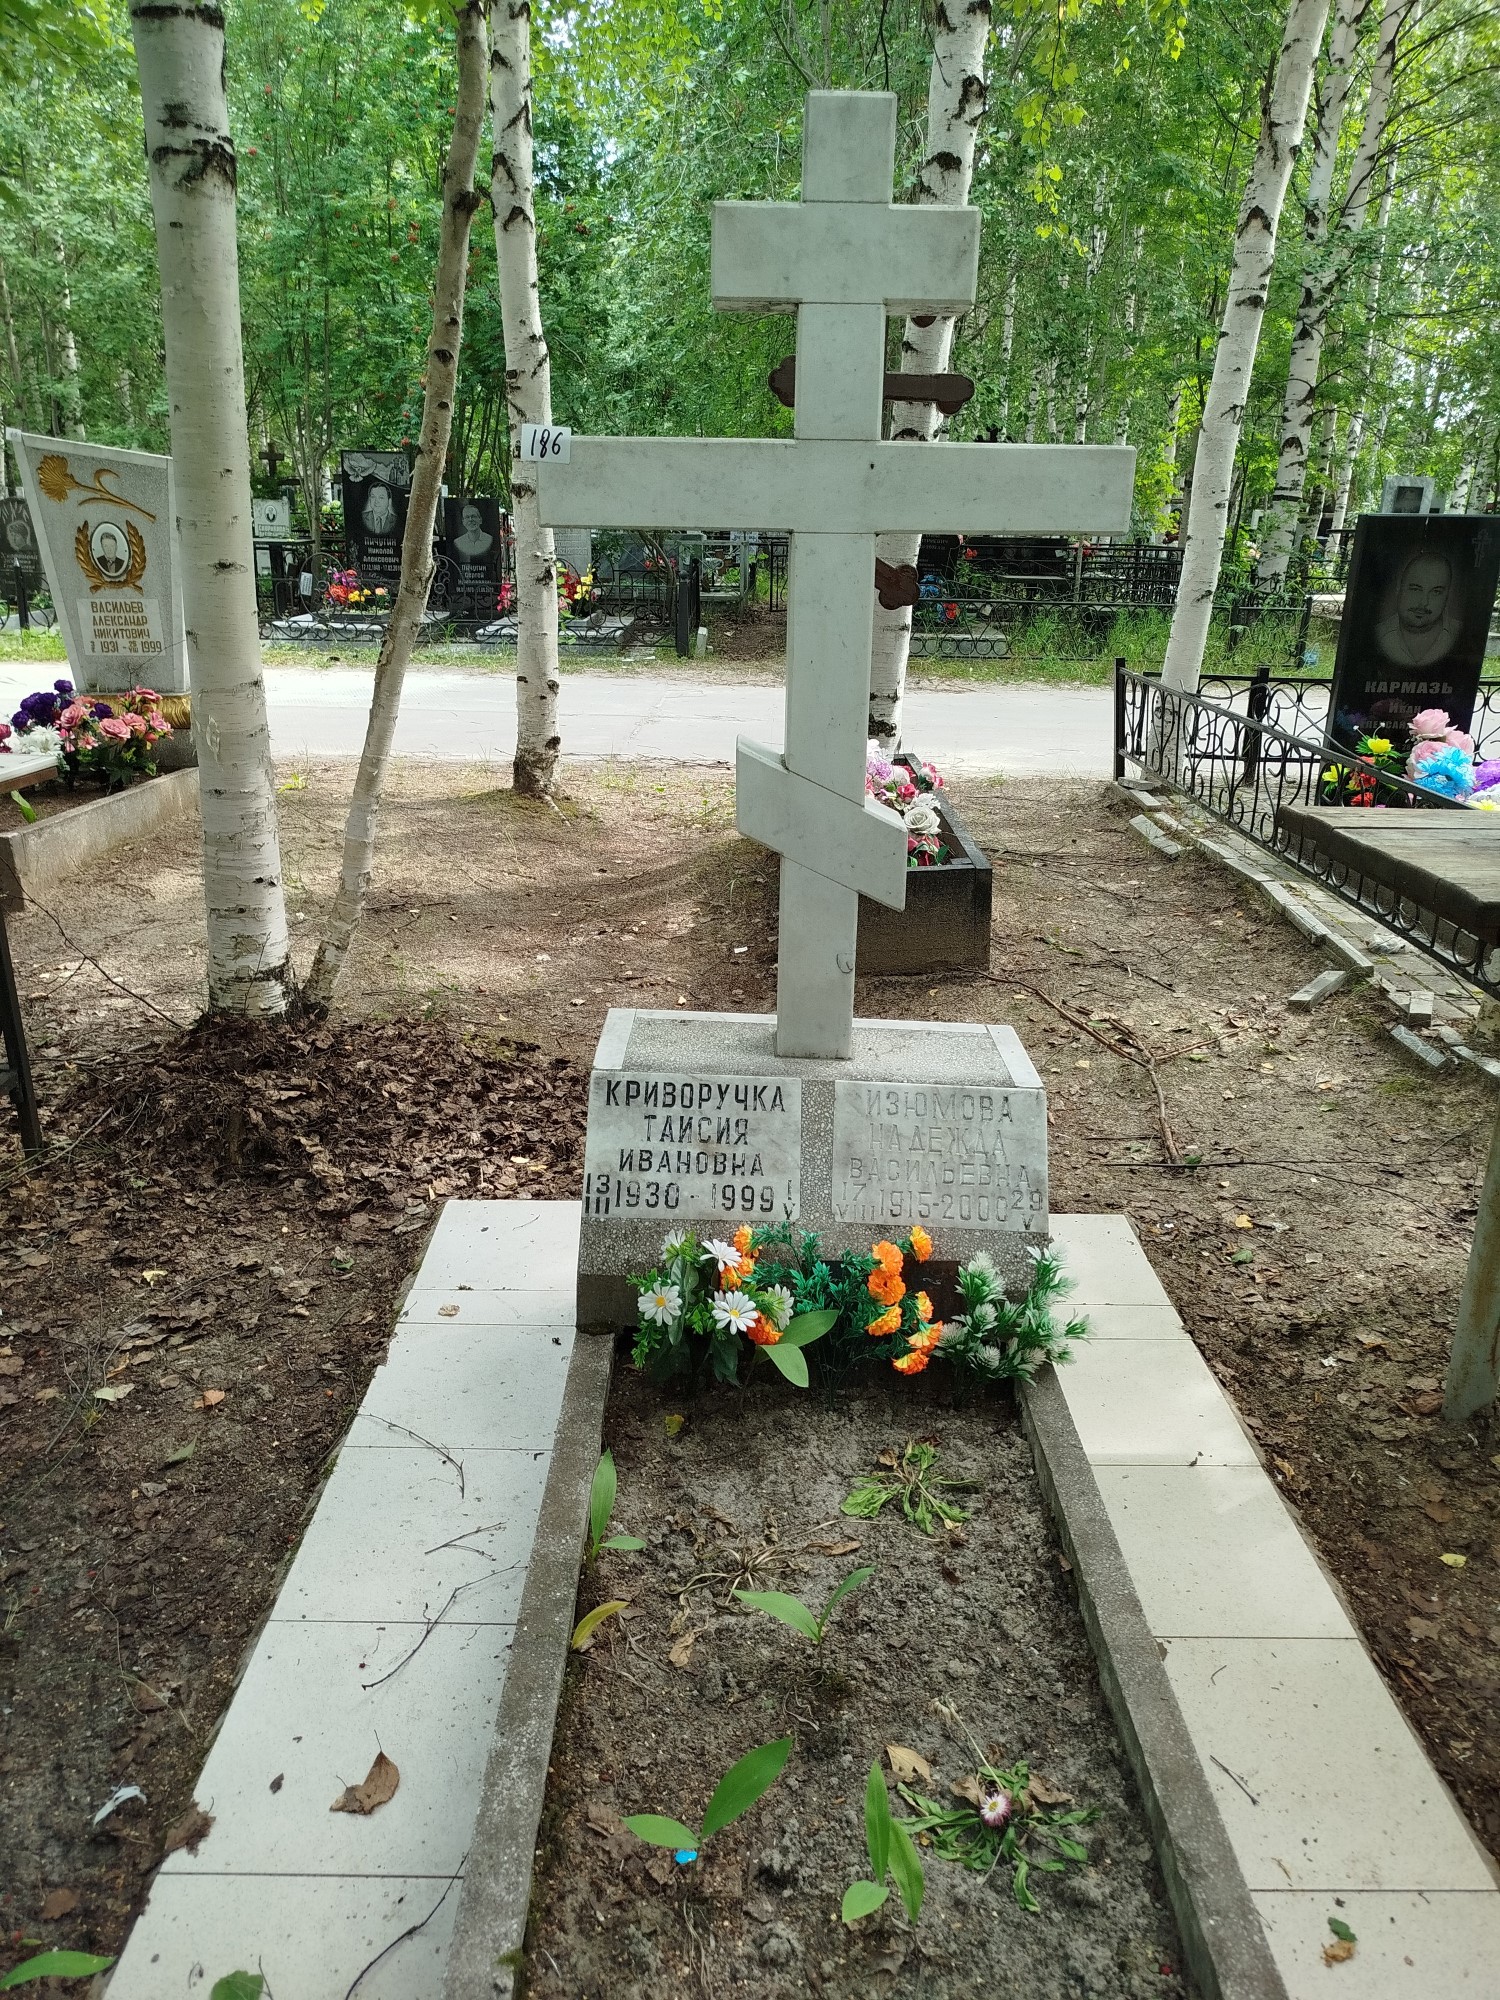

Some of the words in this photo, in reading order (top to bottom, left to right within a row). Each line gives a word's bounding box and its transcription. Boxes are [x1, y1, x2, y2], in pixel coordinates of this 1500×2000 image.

[530, 428, 564, 459] 186
[90, 600, 144, 614] ВАСИЛЬЕВ
[92, 615, 148, 627] АЛЕКСАНДР
[93, 628, 151, 639] НИКИТОВИЧ
[100, 640, 119, 653] 1931
[140, 640, 163, 654] 1999
[1364, 680, 1453, 695] КАРМАЗЬ
[605, 1079, 786, 1113] КРИВОРУЧКА
[865, 1089, 1013, 1123] ИЗЮМОВА
[643, 1113, 749, 1146] ТАИСИЯ
[869, 1122, 1008, 1162] НАДЕЖДА
[618, 1148, 765, 1177] ИВАНОВНА
[849, 1156, 1032, 1189] ВАСИЛЬЕВНА
[585, 1172, 611, 1195] 13
[841, 1181, 867, 1202] 17
[583, 1196, 611, 1215] III
[614, 1179, 680, 1210] 1930
[711, 1182, 775, 1213] 1999
[1010, 1188, 1044, 1212] 29
[783, 1202, 796, 1221] V
[1020, 1213, 1035, 1231] V
